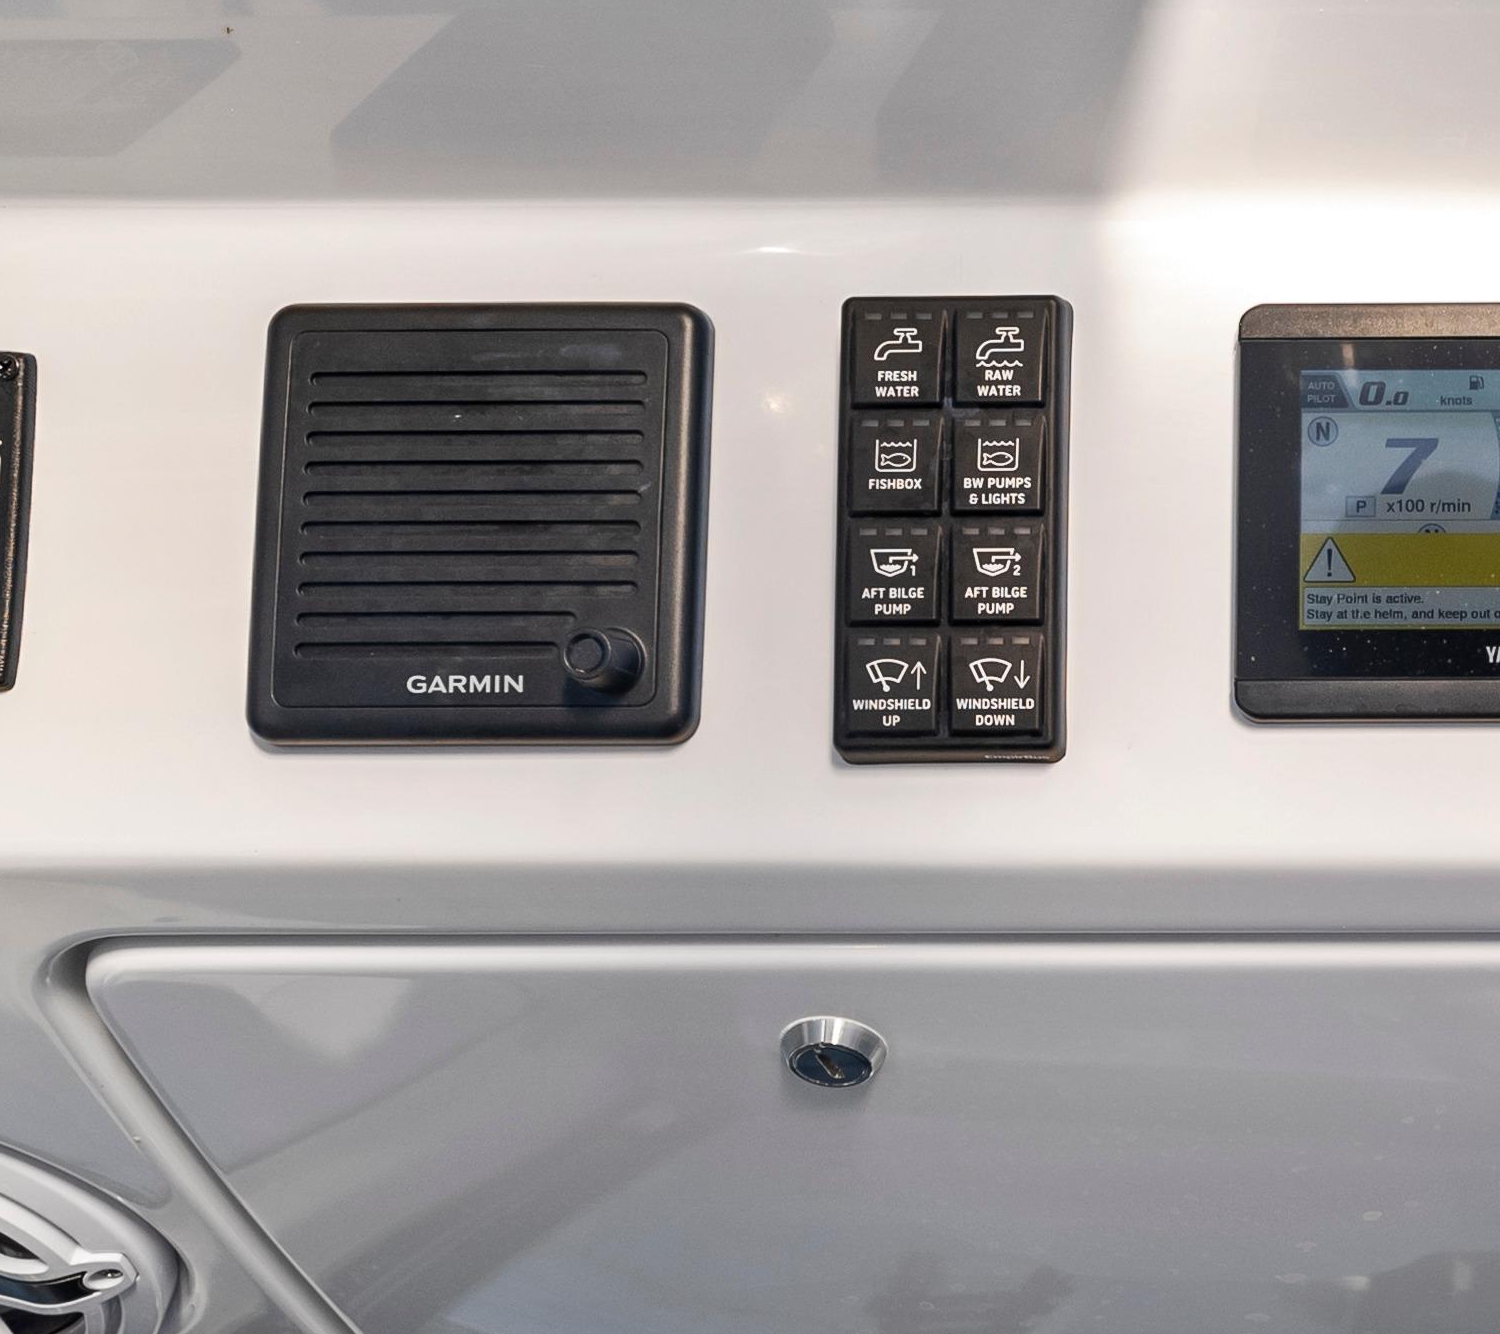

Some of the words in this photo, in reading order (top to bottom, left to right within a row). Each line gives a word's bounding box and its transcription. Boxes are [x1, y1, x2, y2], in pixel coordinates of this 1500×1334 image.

[878, 371, 917, 381] FRESH
[985, 370, 1013, 381] RAW
[875, 386, 919, 397] WATER
[977, 386, 1021, 396] WATER
[1308, 382, 1335, 390] AUTO
[1307, 394, 1335, 403] PILOT
[1359, 381, 1409, 406] 0.0
[1440, 396, 1473, 405] knots
[1316, 422, 1330, 440] N
[1381, 438, 1439, 494] 7
[869, 479, 922, 489] FISHBOX
[964, 478, 984, 488] BW
[987, 477, 1031, 488] PUMPS
[969, 494, 978, 504] &
[981, 493, 1025, 504] LIGHTS
[1356, 501, 1366, 512] P
[1386, 500, 1425, 513] x100
[1430, 499, 1471, 513] r/min
[910, 566, 916, 576] 1
[1013, 565, 1021, 576] 2
[862, 588, 885, 599] AFT
[889, 588, 924, 598] BILGE
[965, 587, 988, 598] AFT
[992, 587, 1027, 598] BILGE
[1307, 594, 1333, 606] Stay
[1337, 594, 1368, 604] Point
[1372, 594, 1382, 604] is
[1386, 594, 1424, 604] active.
[874, 604, 911, 615] PUMP
[978, 603, 1014, 614] PUMP
[1307, 609, 1333, 621] Stay
[1337, 609, 1348, 618] at
[1411, 609, 1434, 618] and
[1438, 609, 1467, 621] keep
[1471, 609, 1490, 618] out
[406, 675, 524, 694] GARMIN
[853, 699, 931, 710] WINDSHIELD
[956, 698, 1034, 710] WINDSHIELD
[883, 716, 900, 726] UP
[976, 715, 1015, 725] DOWN
